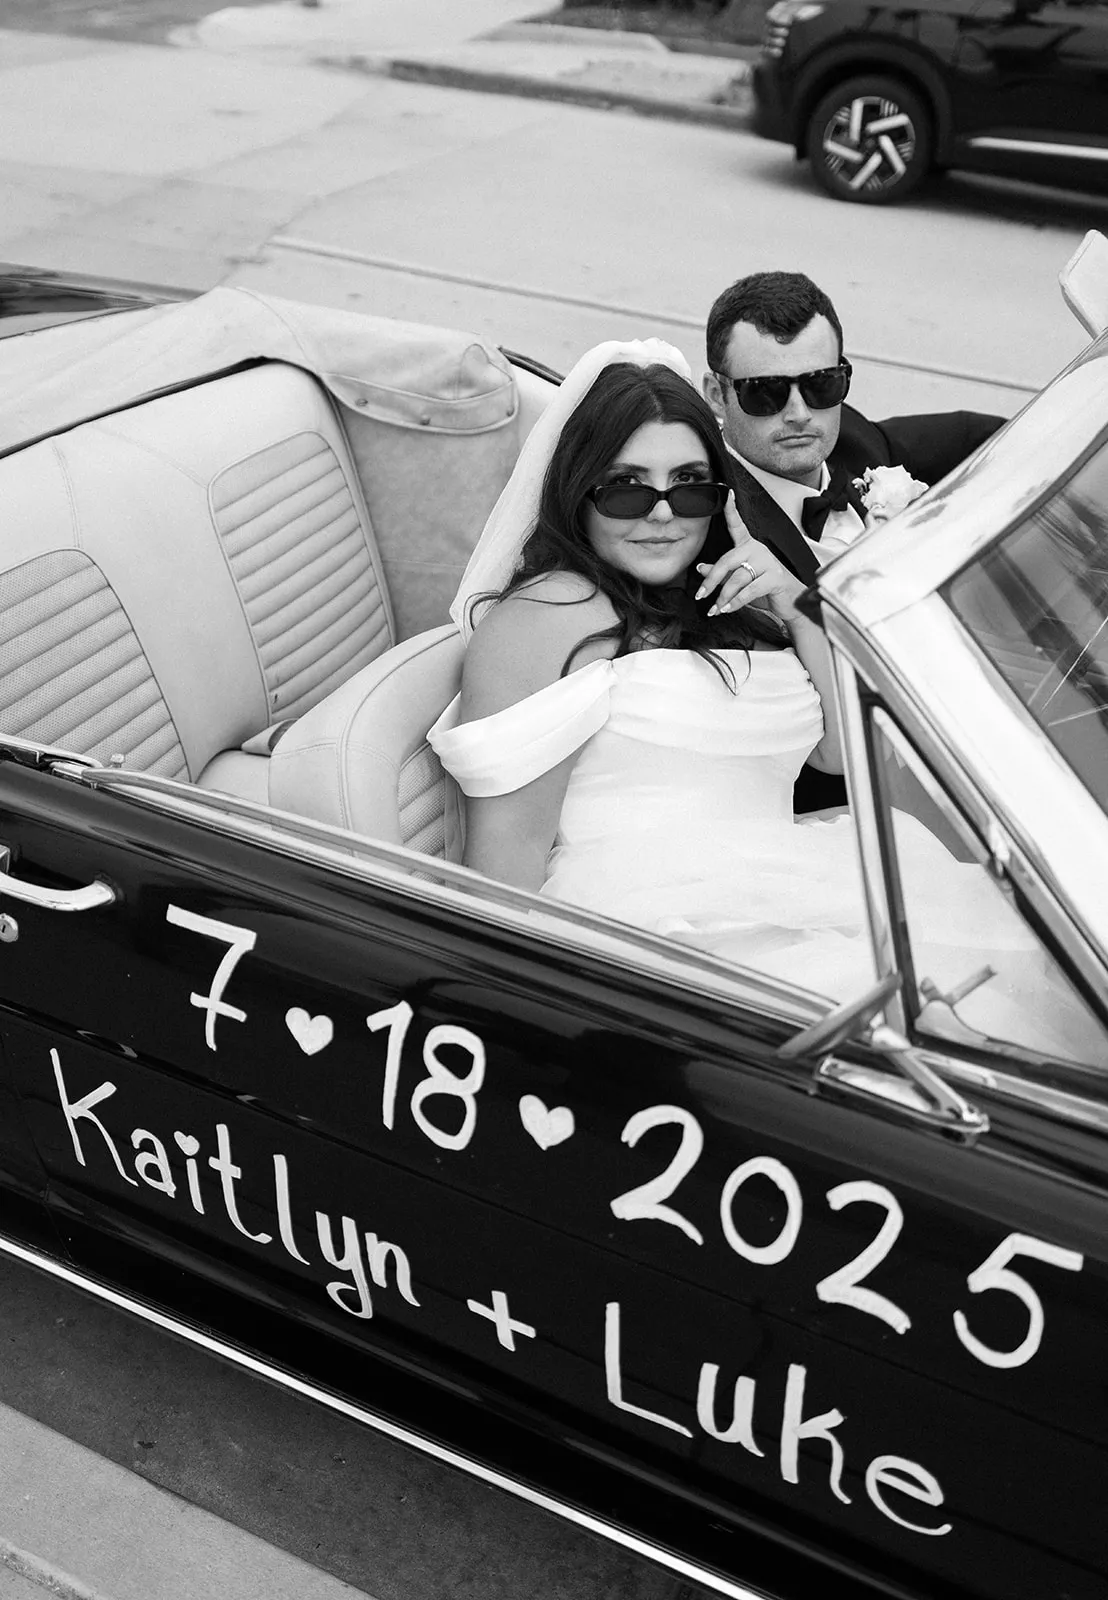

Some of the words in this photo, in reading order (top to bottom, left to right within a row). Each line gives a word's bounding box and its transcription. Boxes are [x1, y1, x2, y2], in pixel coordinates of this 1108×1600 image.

[49, 1047, 421, 1319] Kaitlyn
[466, 1290, 536, 1352] +
[604, 1301, 953, 1536] Luke
[166, 903, 257, 1052] 7
[366, 1000, 486, 1151] 18
[610, 1104, 1084, 1369] 2025
